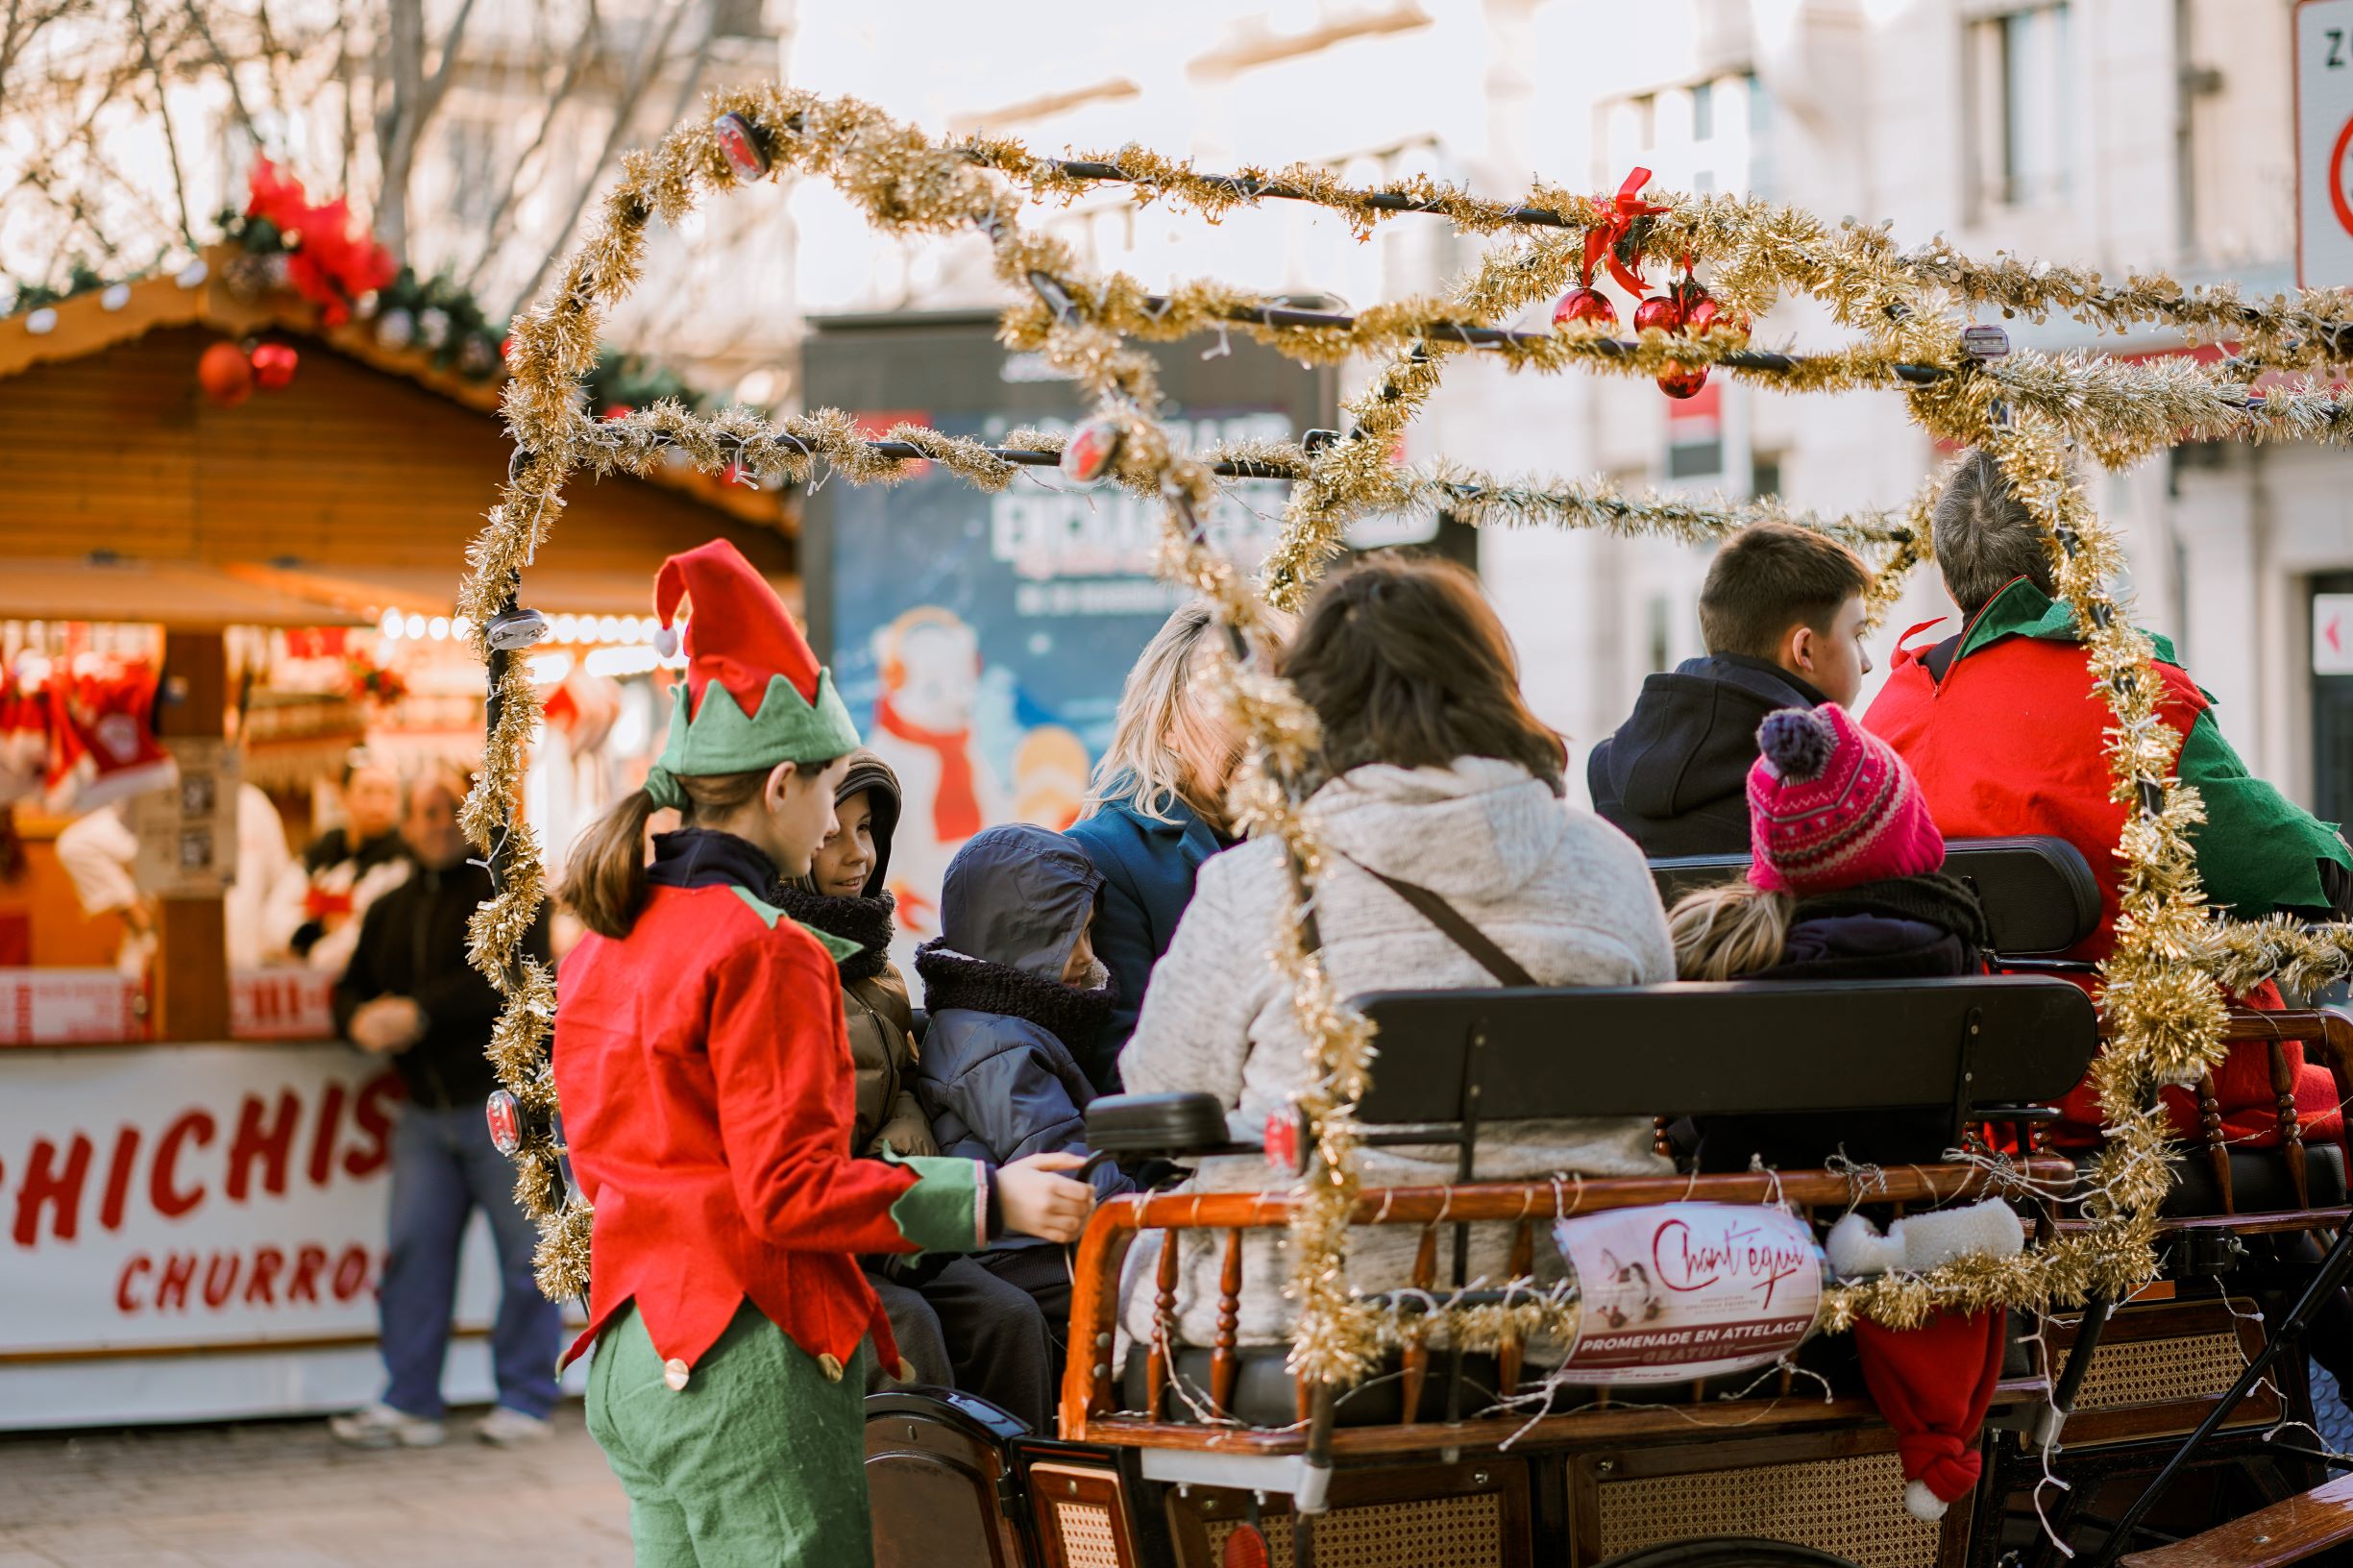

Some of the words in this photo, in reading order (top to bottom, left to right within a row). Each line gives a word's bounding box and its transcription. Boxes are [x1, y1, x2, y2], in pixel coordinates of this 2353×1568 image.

[2325, 30, 2353, 68] Z
[0, 1071, 407, 1246] HICHIS
[116, 1245, 390, 1311] CHURRO
[1581, 1334, 1690, 1352] PROMENADE
[1695, 1328, 1719, 1343] EN
[1721, 1321, 1806, 1339] ATTELAGE
[1641, 1345, 1735, 1362] GRATUIT
